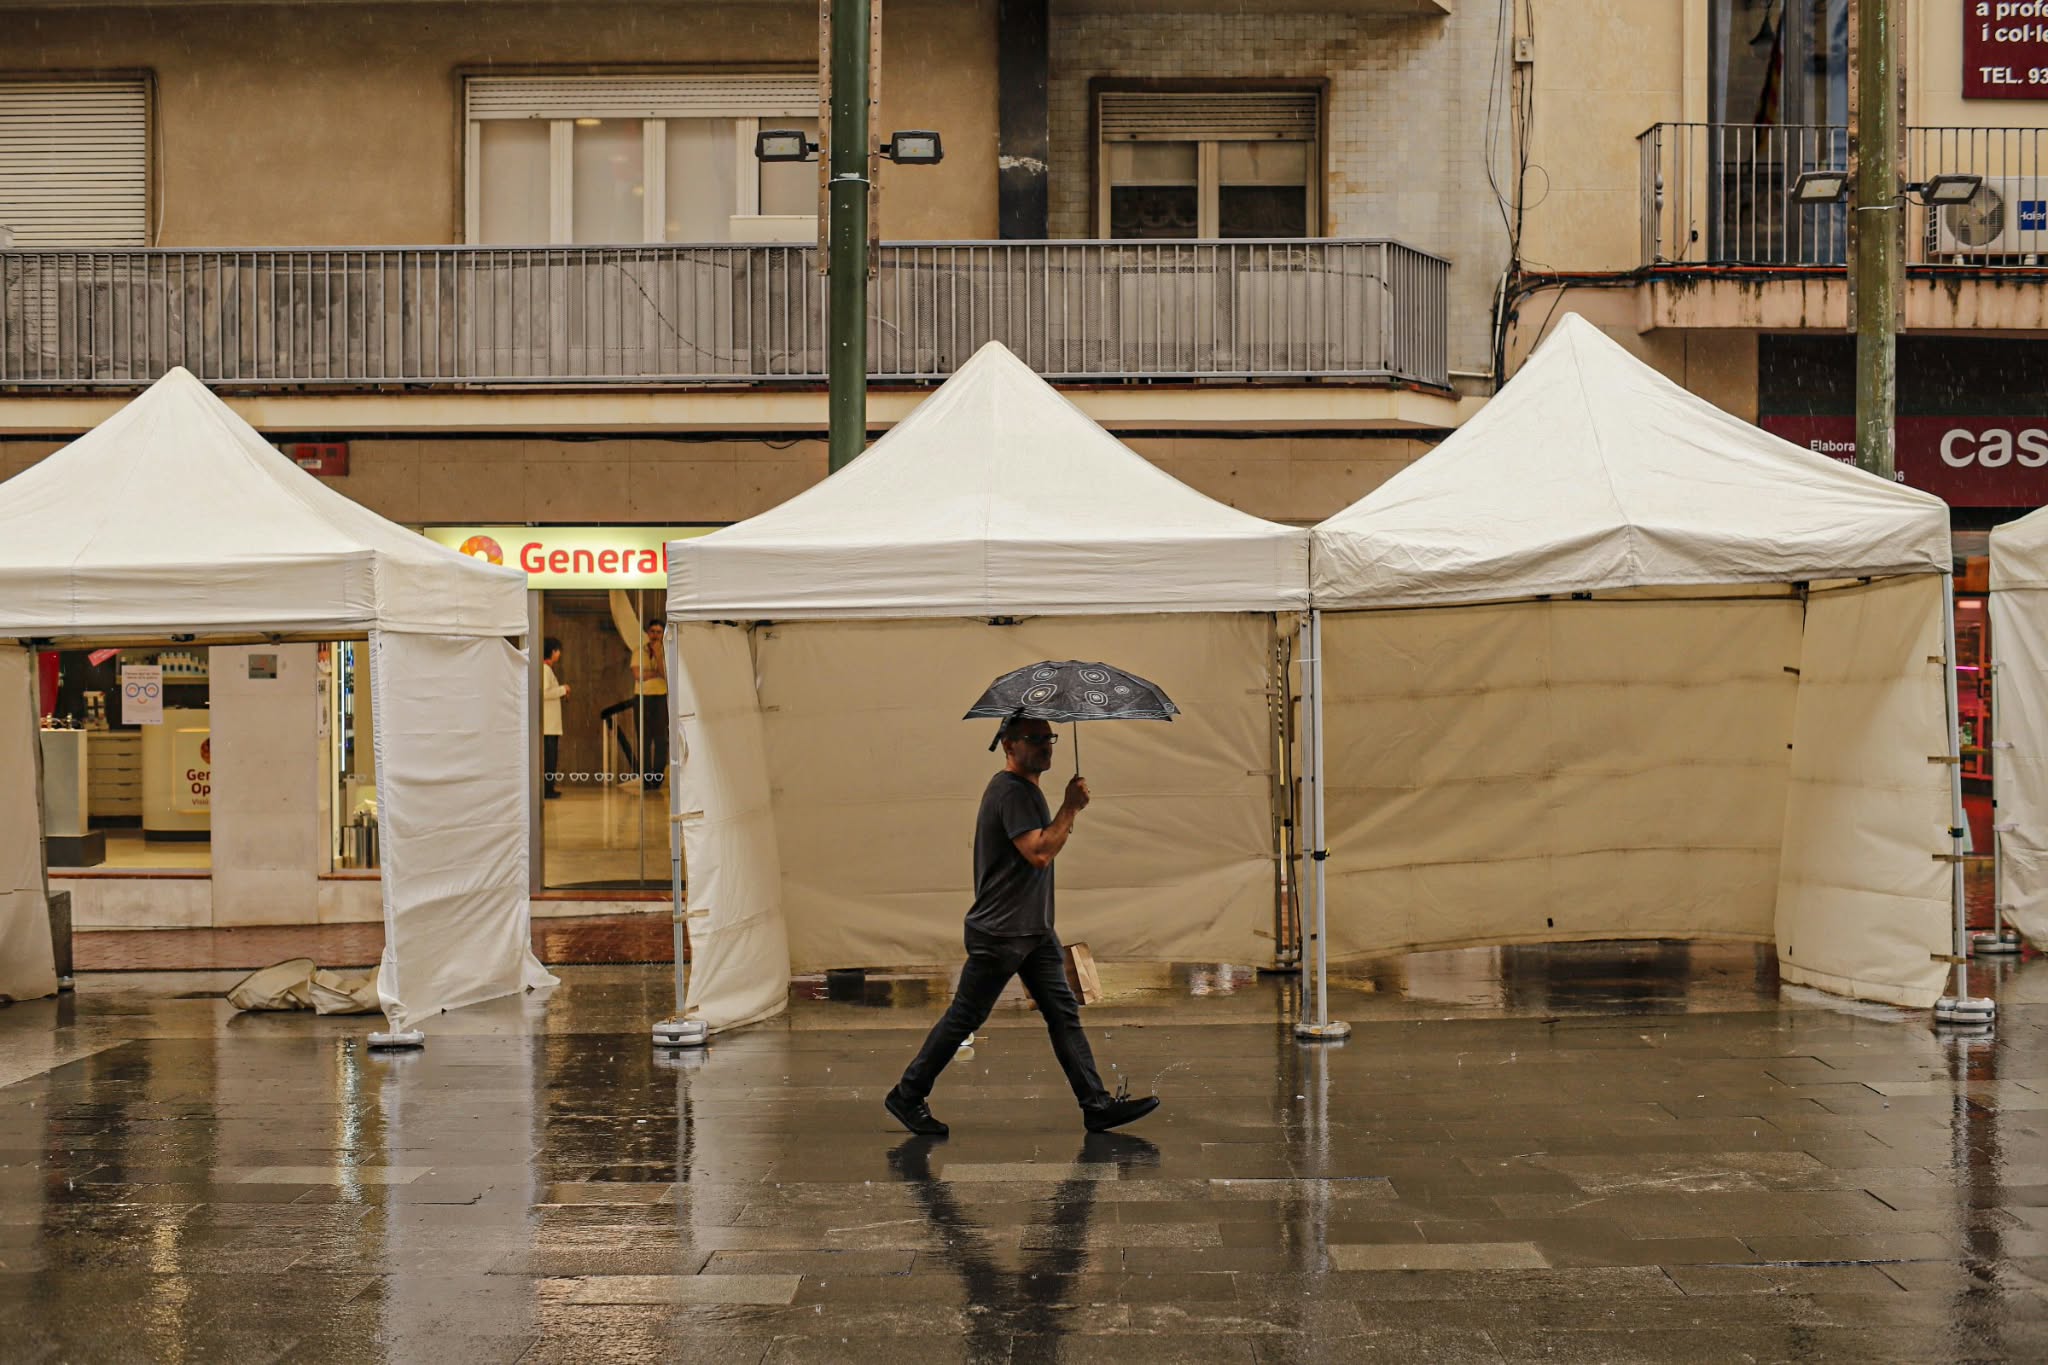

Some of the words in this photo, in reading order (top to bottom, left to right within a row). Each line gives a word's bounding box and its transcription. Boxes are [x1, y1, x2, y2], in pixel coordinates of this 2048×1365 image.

[1975, 1, 1989, 17] a
[1982, 23, 1989, 42] i
[1979, 66, 2023, 85] TEL.
[1810, 439, 1856, 452] Elabora
[1940, 428, 2048, 468] cas
